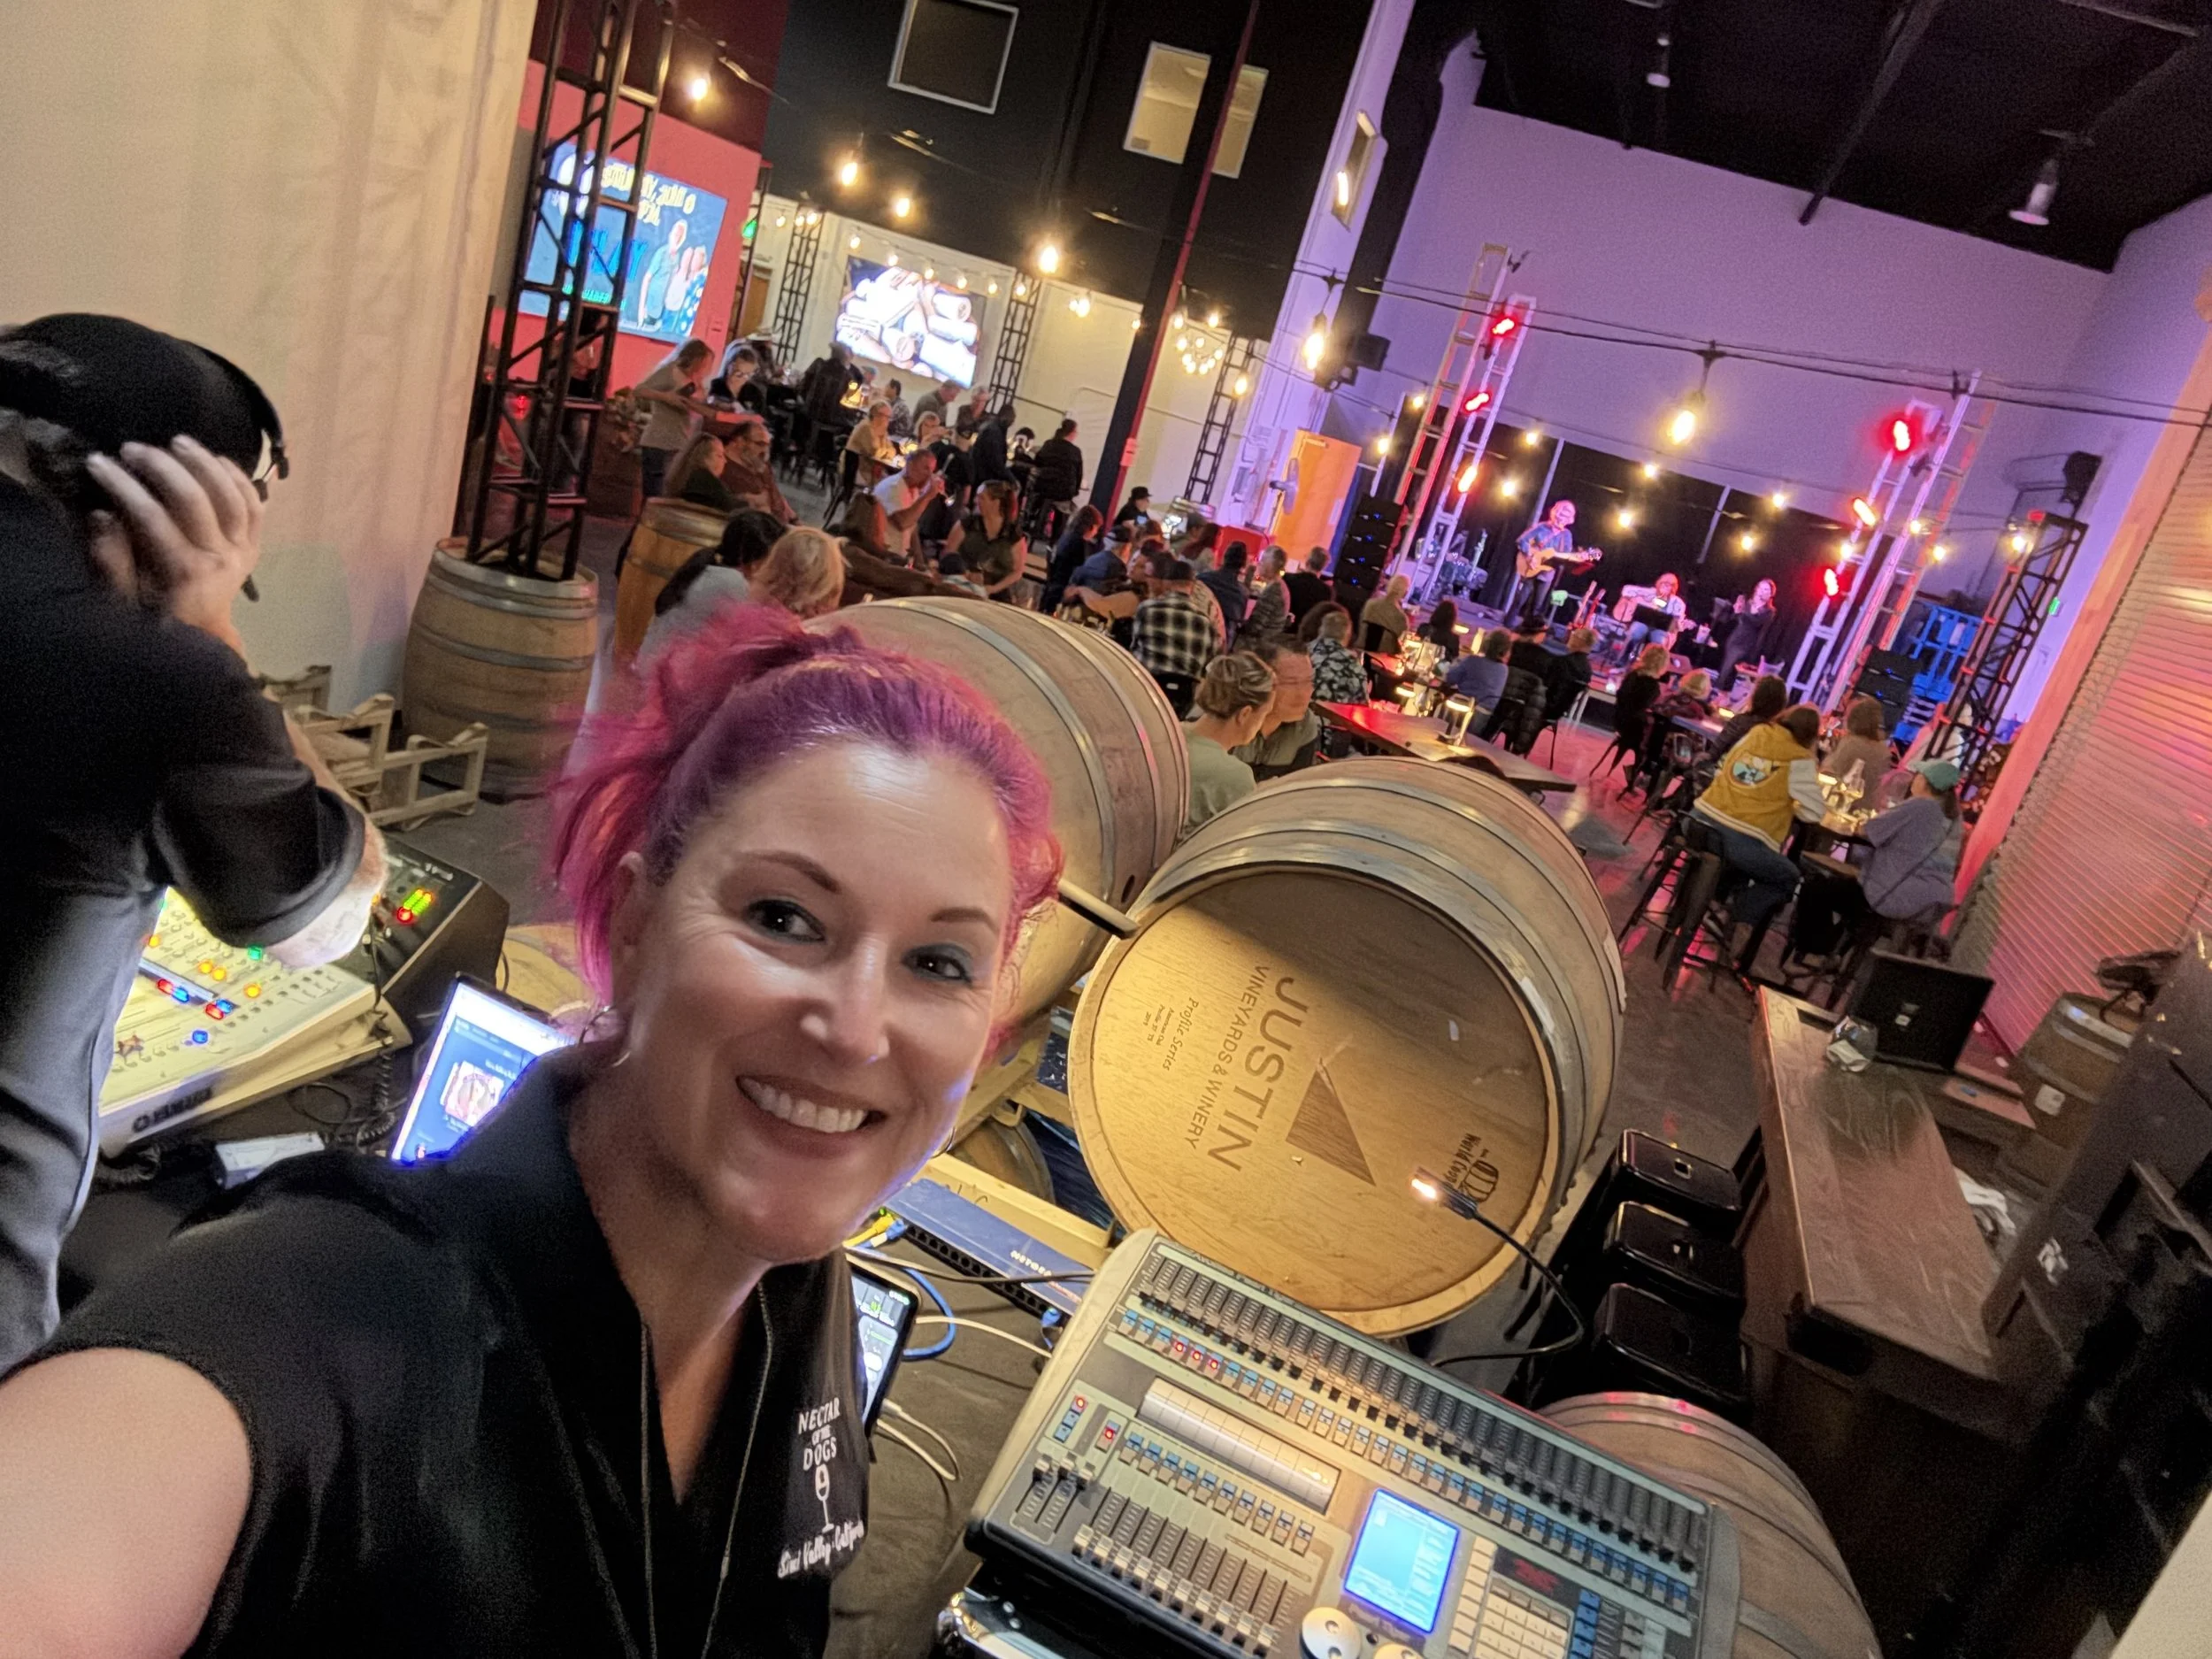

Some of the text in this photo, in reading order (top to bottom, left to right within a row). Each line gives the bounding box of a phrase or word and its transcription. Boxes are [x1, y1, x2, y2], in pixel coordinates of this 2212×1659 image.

[1162, 996, 1200, 1071] Profile Series
[1184, 964, 1271, 1150] VINEYARDS & WINERY
[1207, 976, 1310, 1172] JUSTIN
[1455, 1133, 1482, 1164] World
[798, 1397, 841, 1434] NECTAR
[803, 1436, 837, 1471] DOGS
